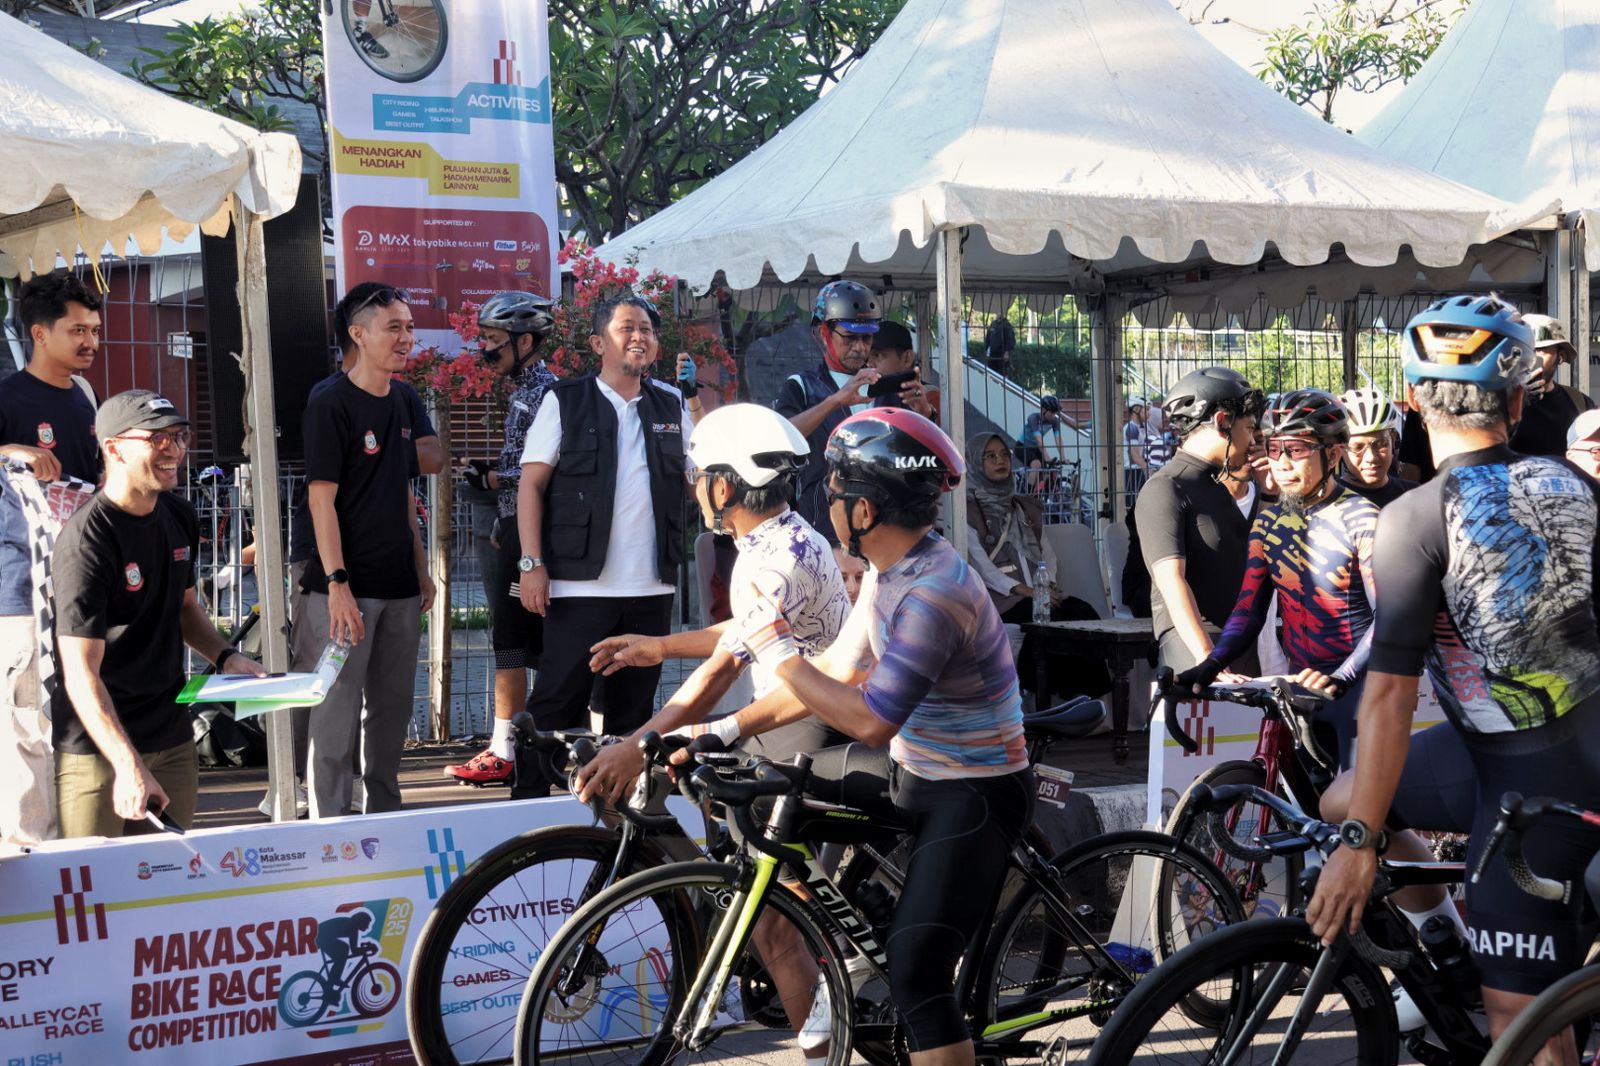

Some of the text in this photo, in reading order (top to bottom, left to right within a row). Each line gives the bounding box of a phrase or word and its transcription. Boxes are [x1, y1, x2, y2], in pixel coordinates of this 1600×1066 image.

[342, 145, 422, 158] MENANGKAN
[359, 158, 405, 169] HADIAH
[443, 165, 481, 174] PULUHAN
[482, 167, 501, 175] JUTA
[443, 174, 512, 184] HADIAH MENARIK
[412, 238, 457, 249] tokyobike
[895, 456, 938, 469] KASK
[1038, 780, 1060, 799] 051
[260, 851, 307, 863] Makassar
[389, 902, 410, 918] 20
[466, 896, 577, 926] CTIVITIES
[384, 919, 407, 937] 25
[134, 916, 319, 977] MAKASSAR
[463, 940, 516, 957] RIDING
[452, 969, 511, 988] GAMES
[131, 965, 282, 1020] BIKE RACE
[44, 1018, 105, 1040] RACE
[128, 1006, 277, 1052] COMPETITION
